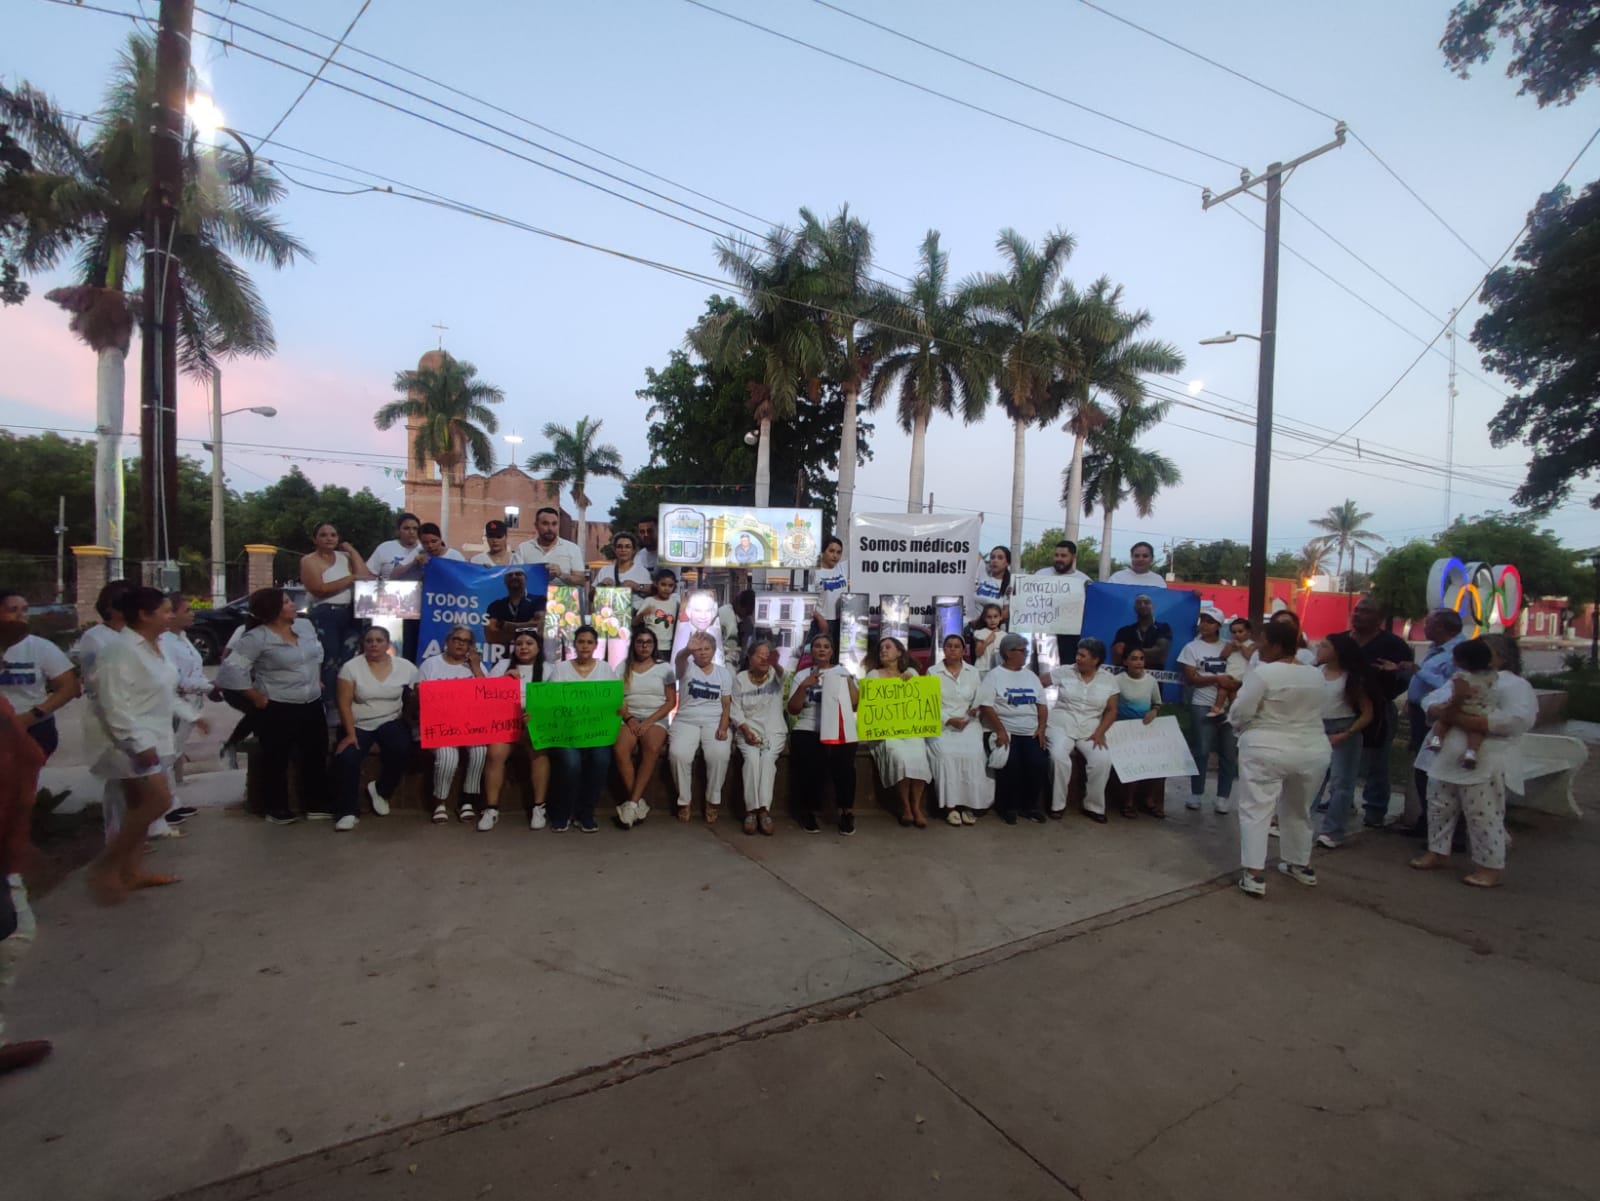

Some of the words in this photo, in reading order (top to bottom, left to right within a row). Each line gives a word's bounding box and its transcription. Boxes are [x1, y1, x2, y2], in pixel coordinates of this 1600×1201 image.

[860, 536, 907, 552] Somos
[910, 537, 970, 553] médicos
[862, 560, 879, 573] no
[882, 559, 967, 574] criminales!!
[426, 592, 479, 609] TODOS
[432, 609, 490, 626] SOMOS
